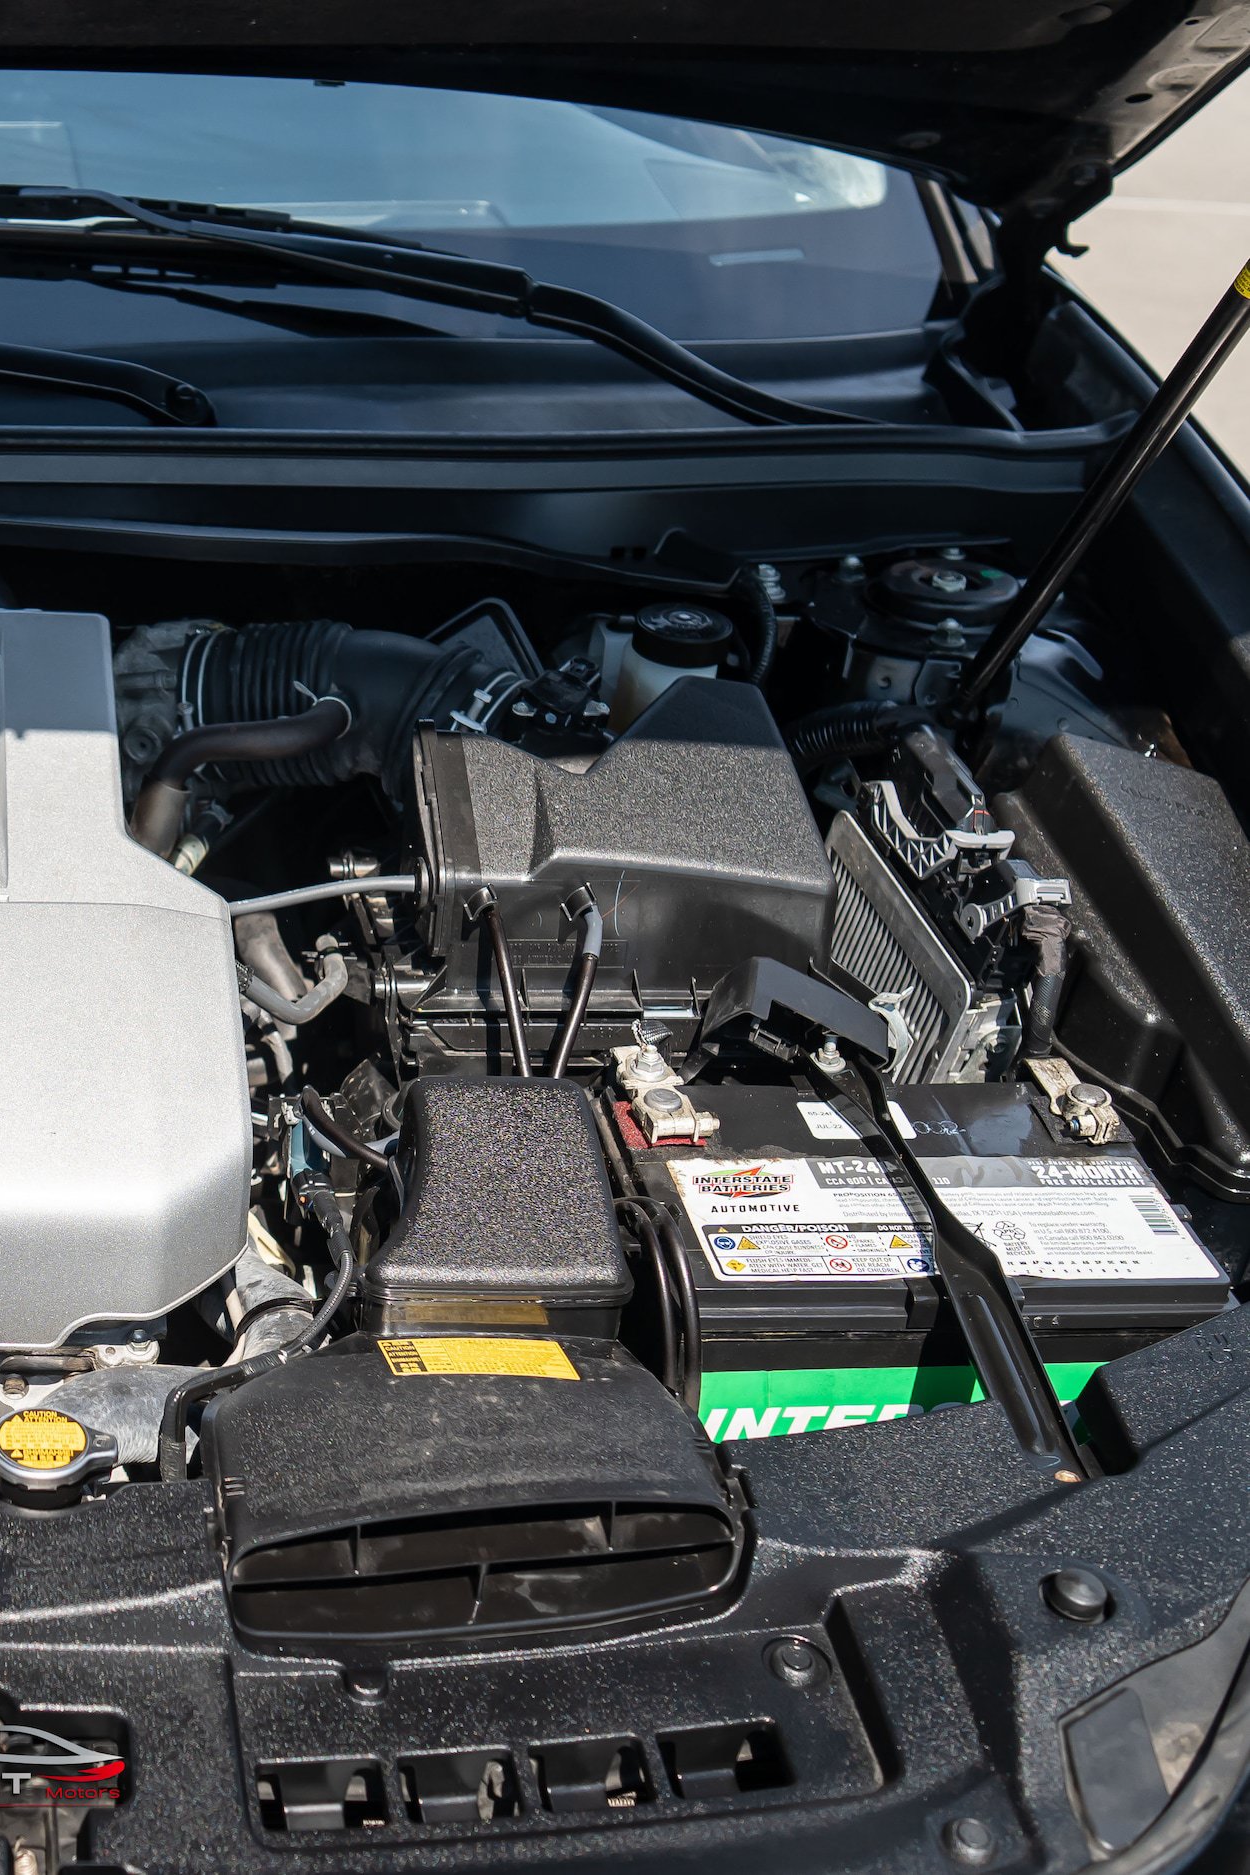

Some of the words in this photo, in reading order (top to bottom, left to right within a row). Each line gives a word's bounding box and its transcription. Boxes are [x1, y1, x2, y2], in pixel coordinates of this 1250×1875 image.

[1030, 1165, 1143, 1179] 24-MONTH
[694, 1176, 791, 1184] INTERSTATE
[701, 1184, 788, 1192] BATTERIES
[711, 1204, 800, 1213] AUTOMOTIVE
[742, 1224, 850, 1232] DANGER/POISON
